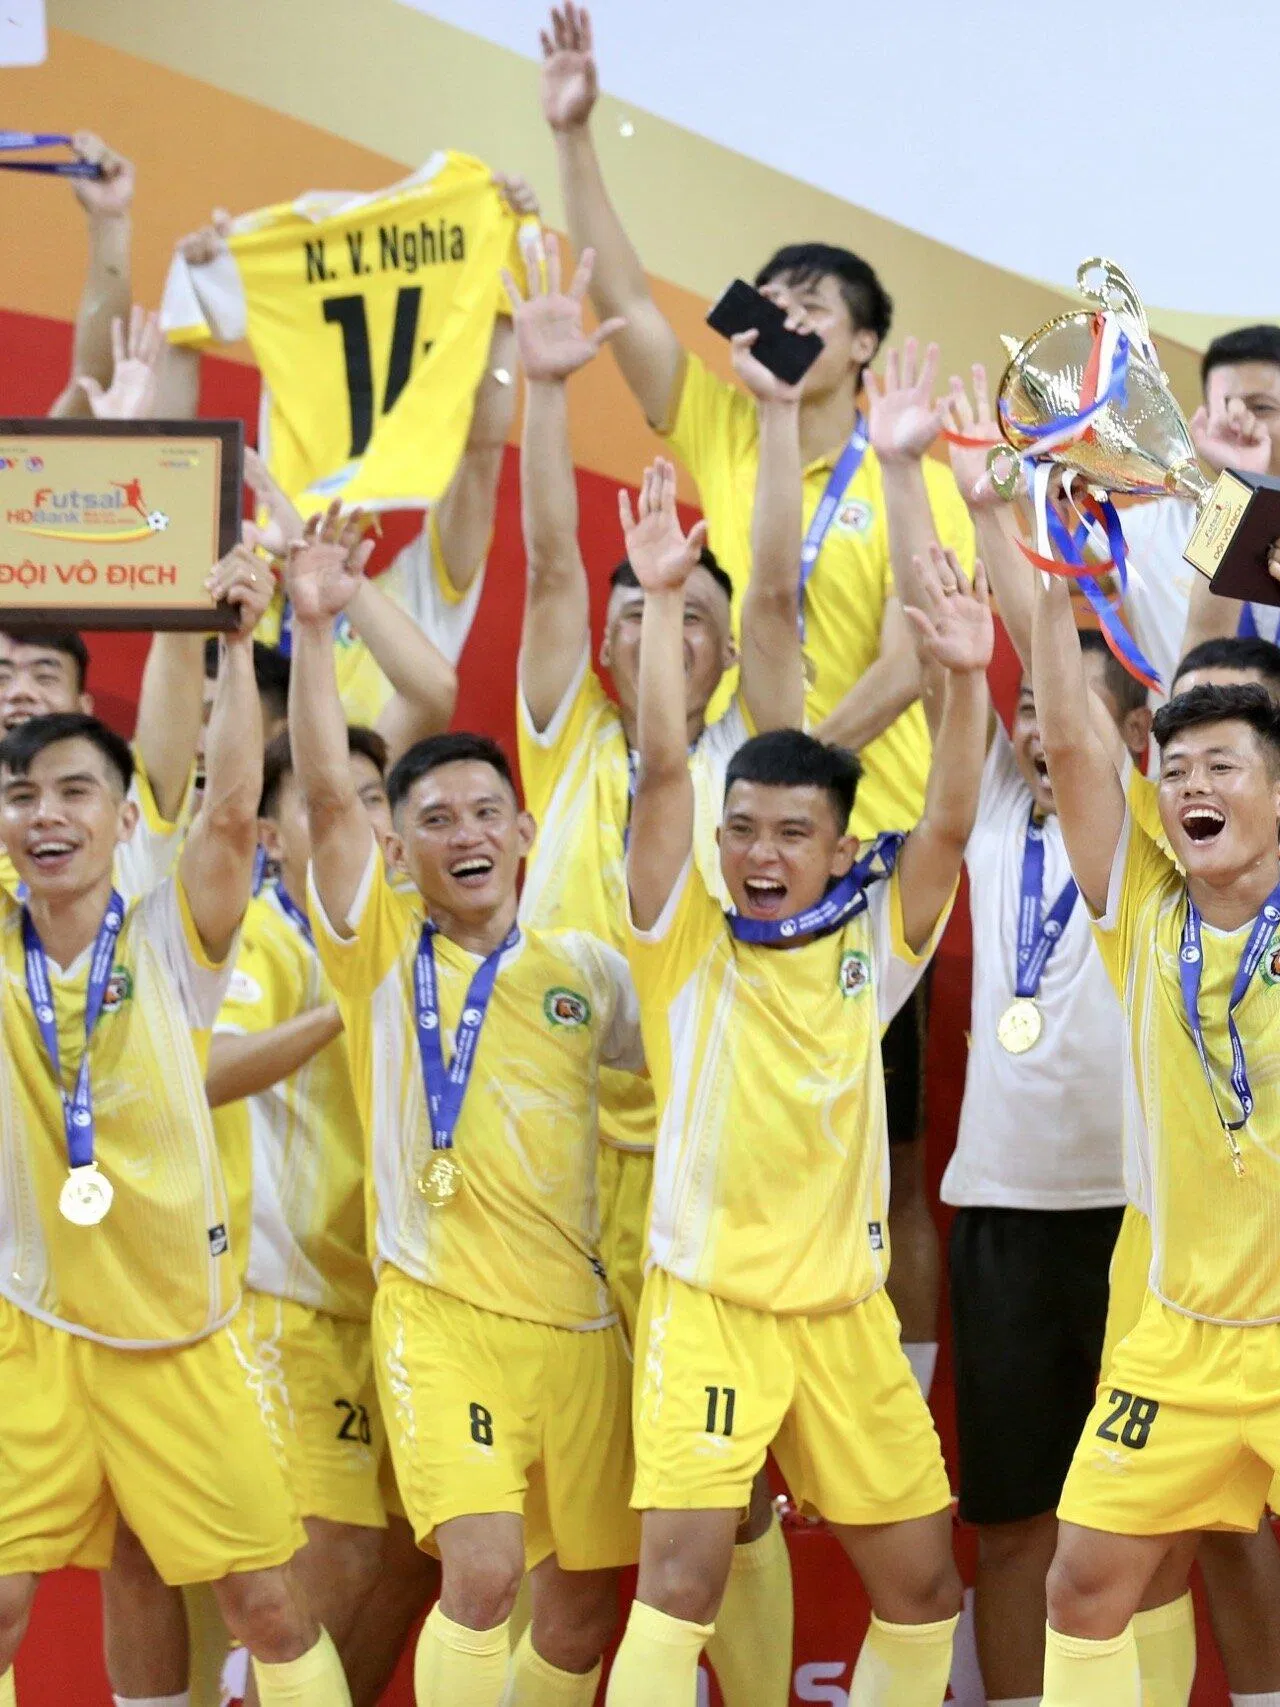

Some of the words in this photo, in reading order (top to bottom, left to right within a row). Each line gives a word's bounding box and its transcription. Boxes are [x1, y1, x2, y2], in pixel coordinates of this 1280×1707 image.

[304, 239, 337, 284] N.
[346, 230, 372, 276] V.
[33, 488, 123, 509] Futsal
[53, 559, 98, 585] VÔ
[106, 564, 177, 590] ĐỊCH
[469, 1402, 493, 1446] 8
[705, 1386, 735, 1436] 11
[1096, 1388, 1160, 1450] 28
